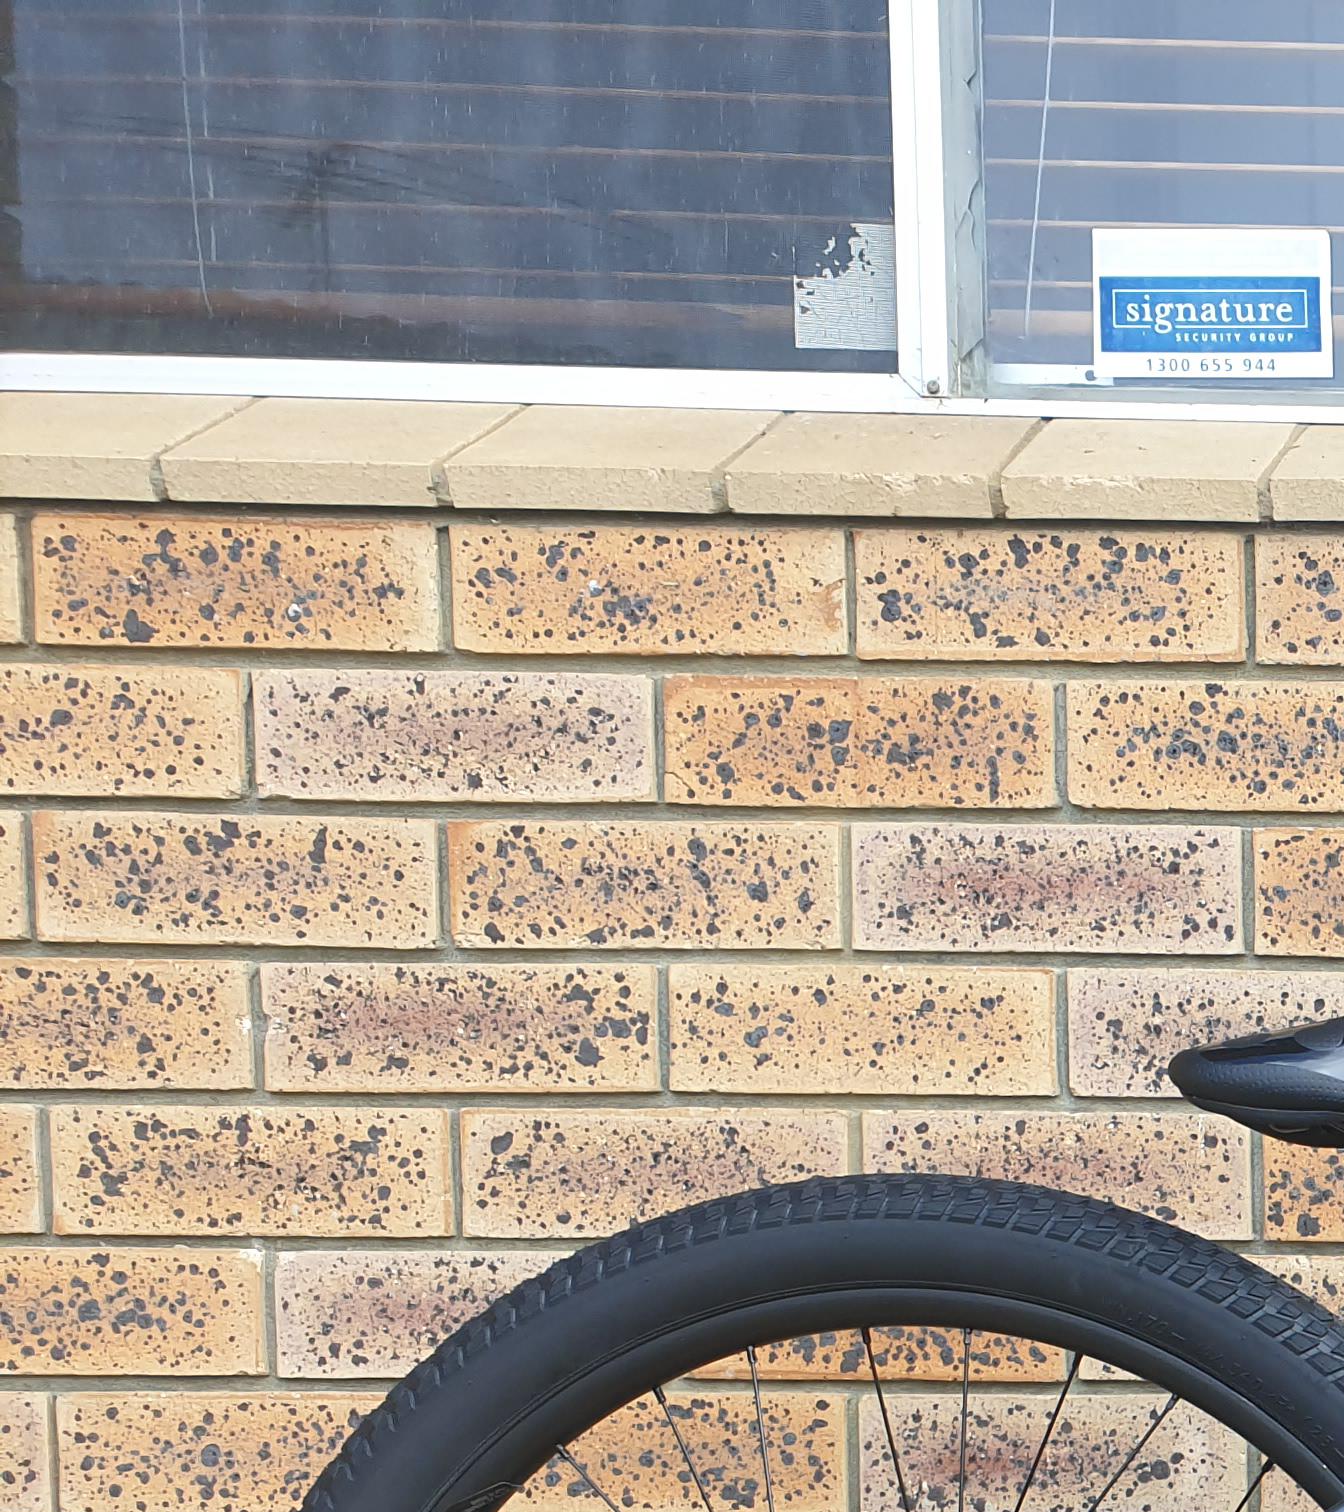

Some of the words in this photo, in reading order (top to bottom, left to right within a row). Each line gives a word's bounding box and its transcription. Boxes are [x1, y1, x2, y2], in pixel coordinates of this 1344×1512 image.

[1125, 294, 1293, 334] signature
[1175, 333, 1241, 343] SECURITY
[1249, 333, 1294, 342] GROUP
[1146, 358, 1190, 372] 1300
[1200, 359, 1233, 371] 655
[1243, 359, 1276, 371] 944
